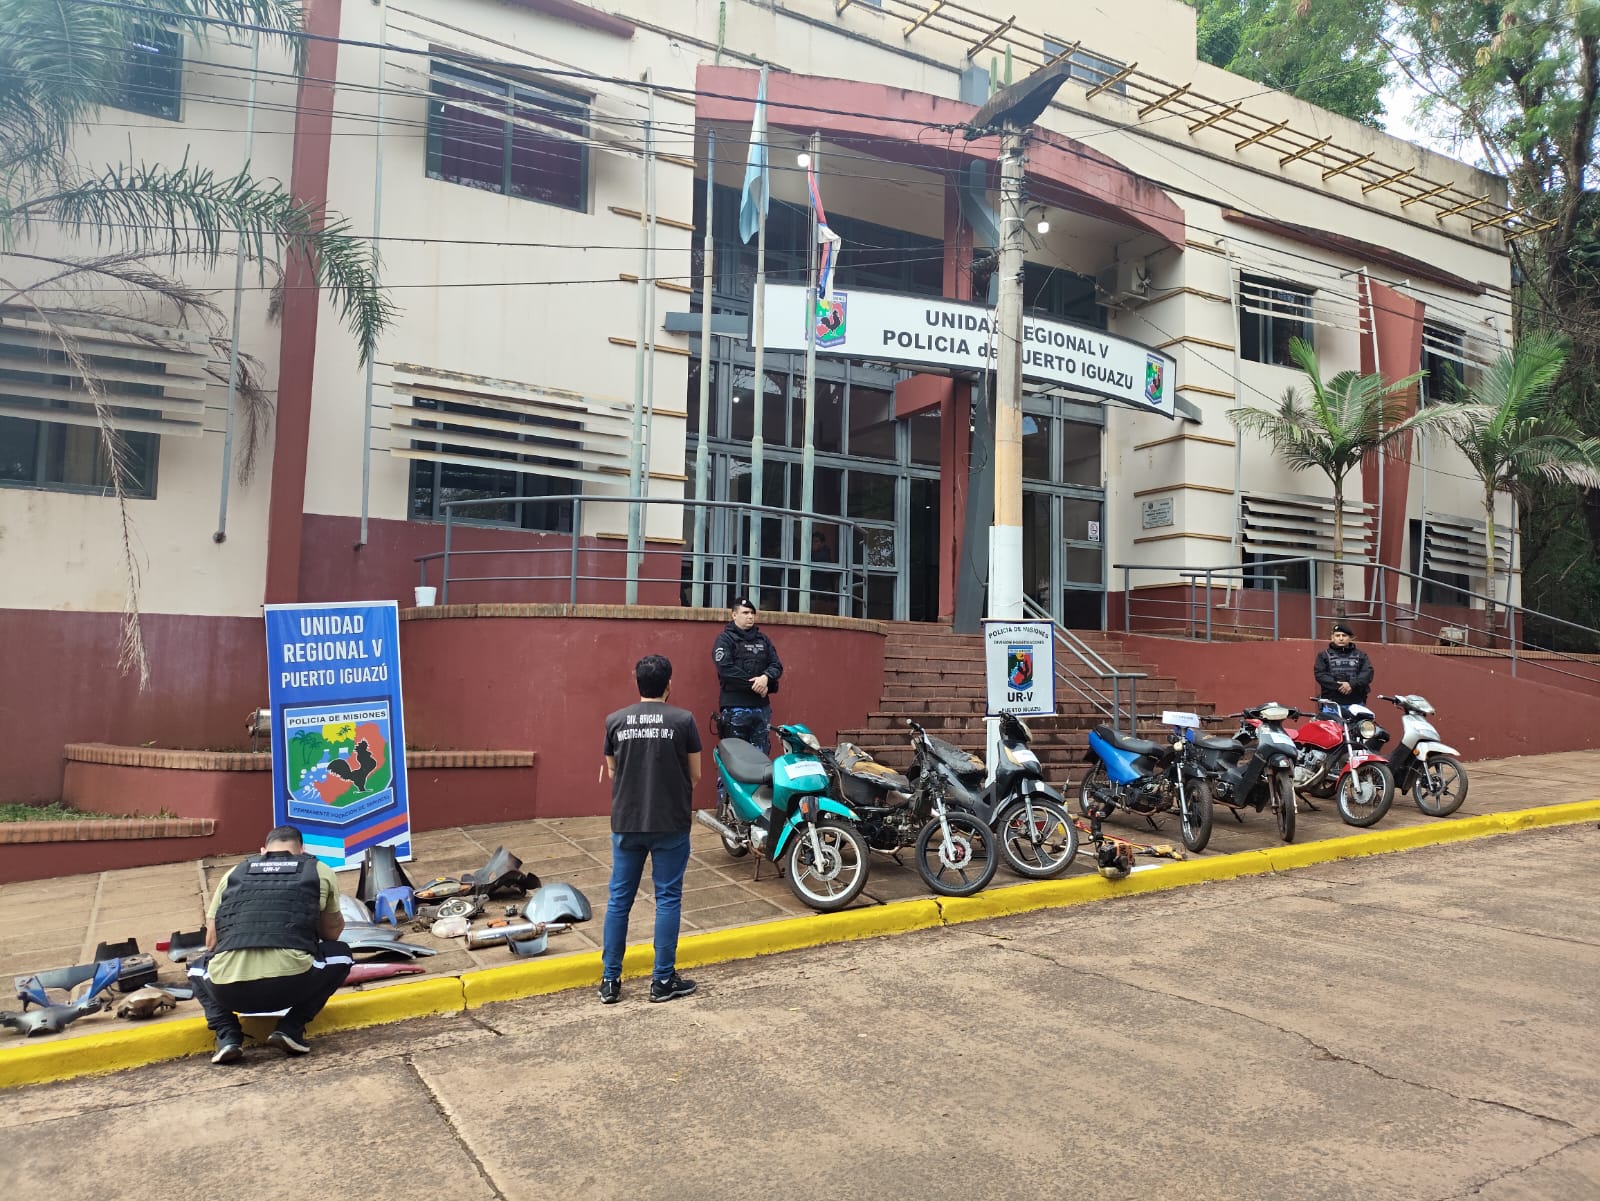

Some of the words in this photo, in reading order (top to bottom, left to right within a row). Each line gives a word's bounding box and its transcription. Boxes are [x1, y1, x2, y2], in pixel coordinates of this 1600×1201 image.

[1023, 325, 1096, 356] EGIONAL
[1099, 343, 1109, 359] V
[883, 330, 970, 355] POLICIA
[1022, 349, 1076, 374] UERTO
[1081, 362, 1133, 389] IGUAZU
[300, 615, 364, 637] UNIDAD
[988, 627, 1012, 639] POLICIA
[1023, 626, 1049, 639] MISIONES
[283, 640, 369, 663] REGIONAL
[371, 638, 383, 657] V
[281, 669, 335, 689] PUERTO
[340, 662, 388, 684] IGUAZÚ
[1007, 692, 1033, 702] UR-V
[289, 715, 326, 726] POLICIA
[328, 714, 340, 723] DE
[342, 710, 386, 721] MISIONES
[639, 714, 663, 724] BRIGADA
